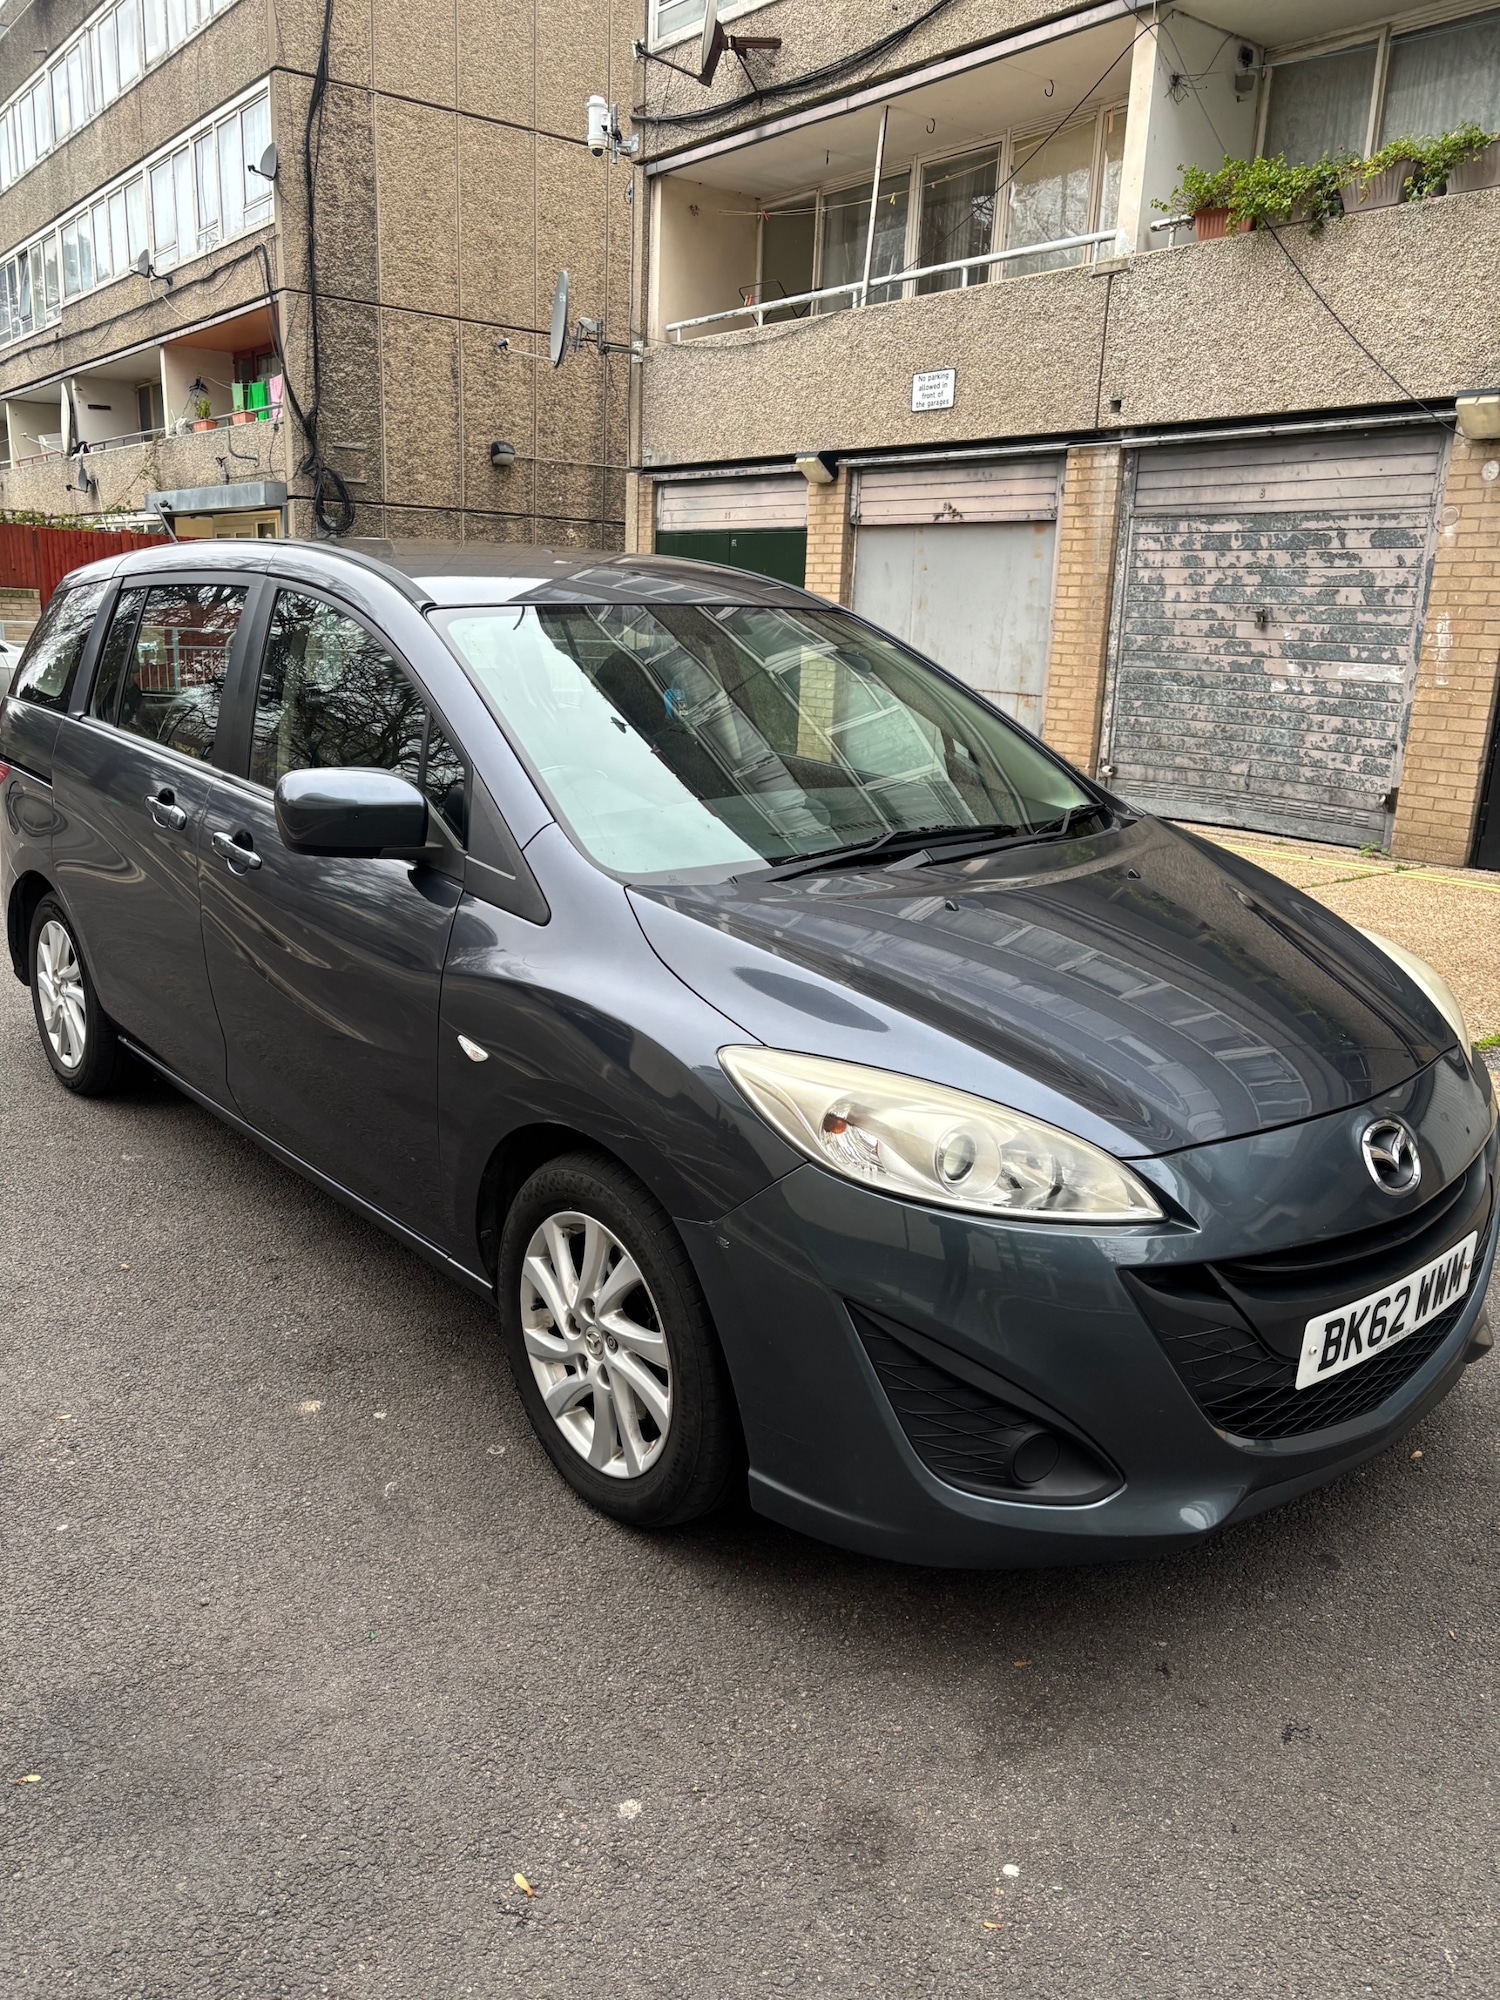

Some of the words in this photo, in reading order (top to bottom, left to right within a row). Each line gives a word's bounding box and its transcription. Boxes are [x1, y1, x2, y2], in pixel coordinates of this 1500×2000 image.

[928, 373, 949, 382] parking
[919, 382, 940, 391] allowed
[927, 399, 949, 408] garages
[1317, 1285, 1411, 1372] BK62
[1414, 1246, 1467, 1321] WWM
